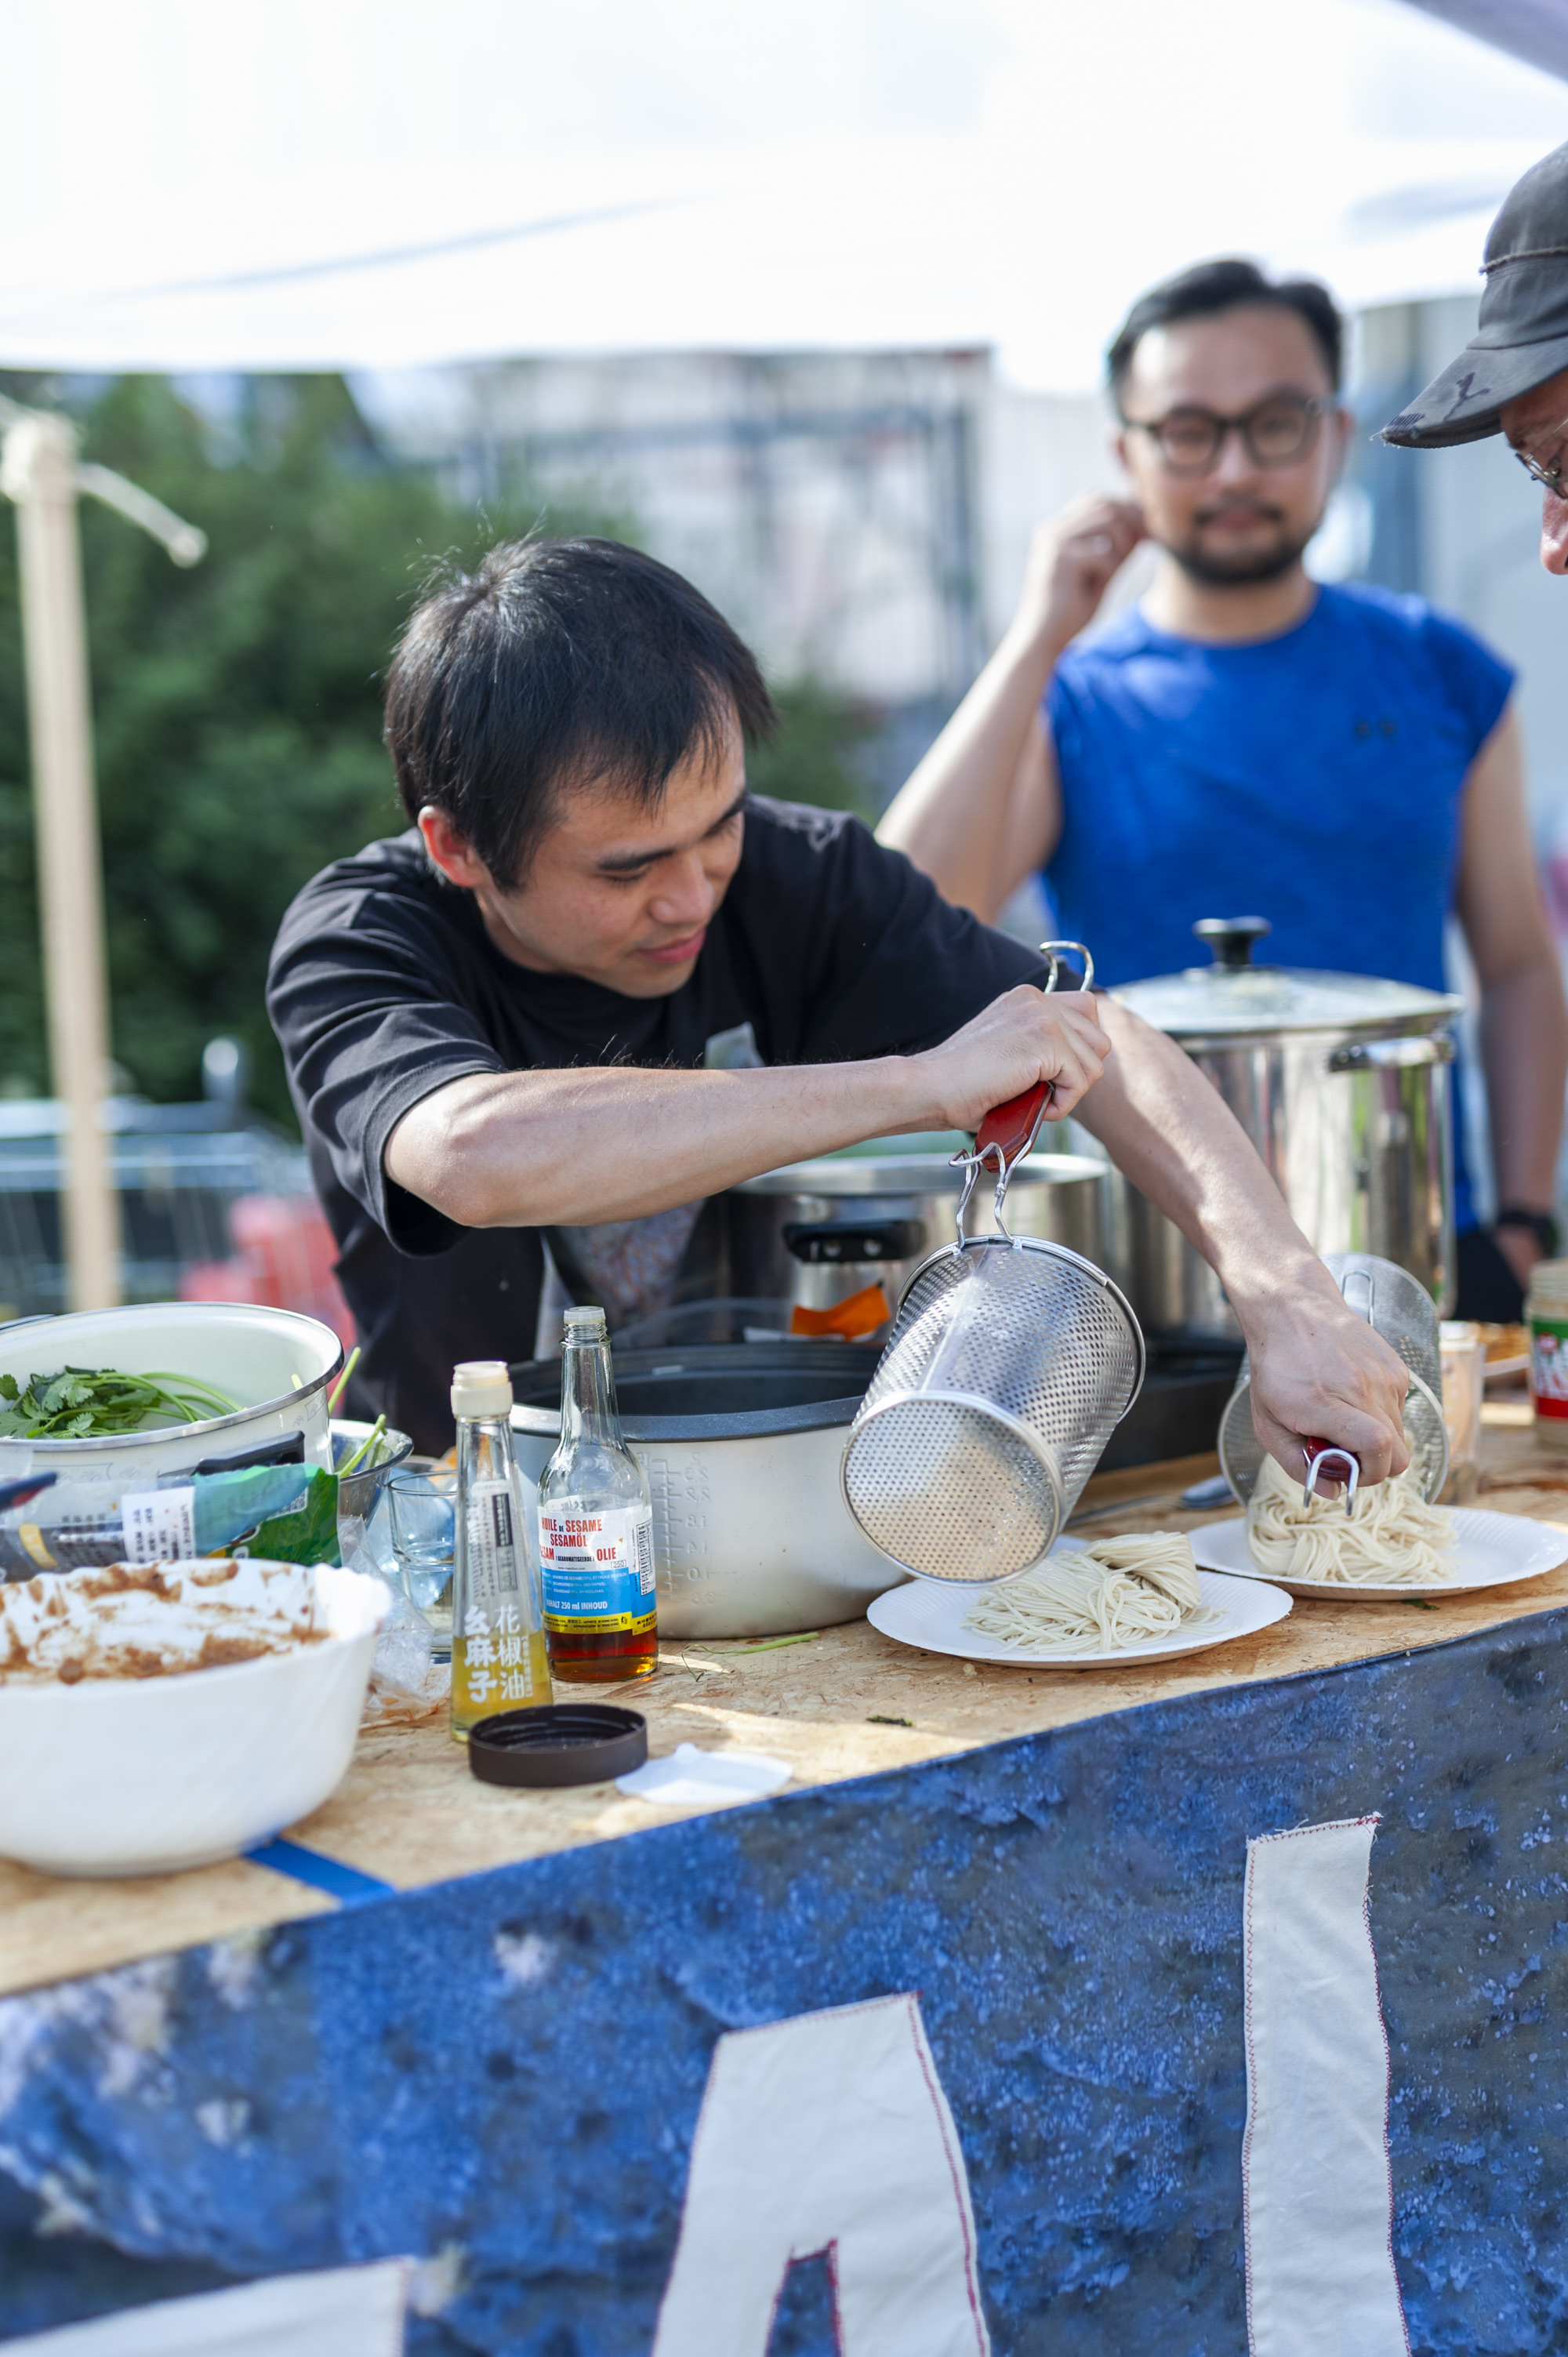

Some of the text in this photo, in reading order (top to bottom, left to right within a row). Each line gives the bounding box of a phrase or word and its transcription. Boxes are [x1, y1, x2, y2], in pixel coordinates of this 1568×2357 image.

[542, 1517, 557, 1531] HUILE
[565, 1519, 602, 1532] SESAME
[550, 1533, 587, 1547] SESAMÖL
[597, 1547, 616, 1561] OLIE
[561, 1601, 571, 1610] 250
[572, 1601, 580, 1610] ml
[581, 1600, 608, 1610] INHOUD
[495, 1604, 525, 1701] 花椒油
